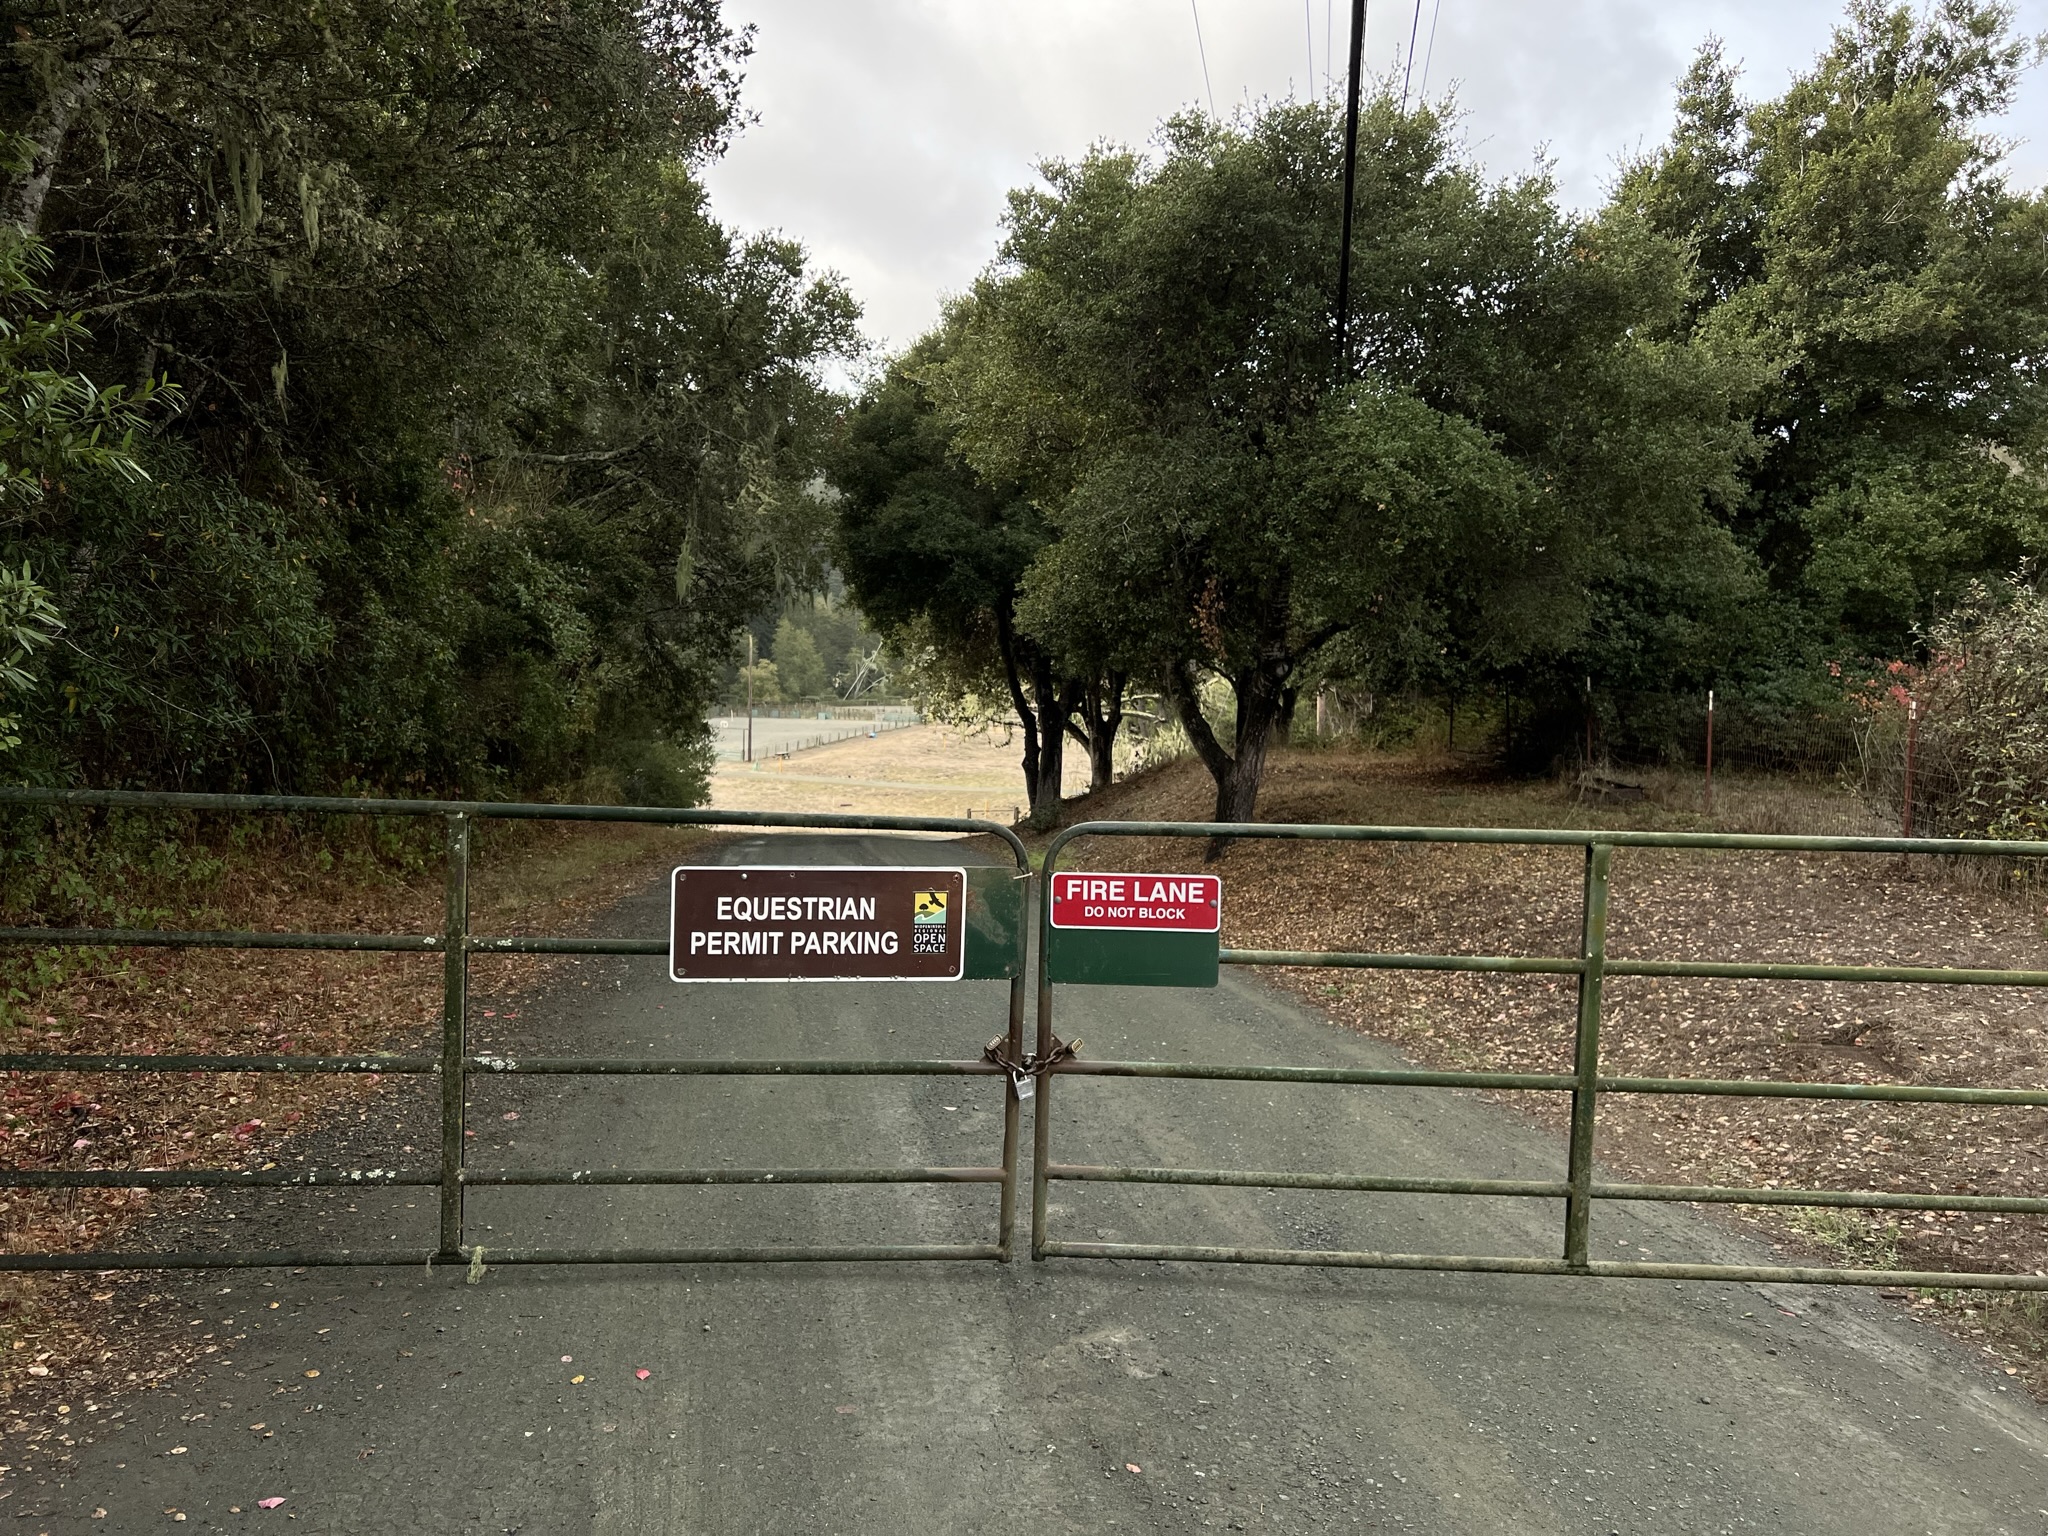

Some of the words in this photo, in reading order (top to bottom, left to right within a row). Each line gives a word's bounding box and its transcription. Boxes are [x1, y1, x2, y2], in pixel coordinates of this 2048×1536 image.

[1067, 880, 1125, 901] FIRE
[1134, 881, 1204, 903] LANE
[717, 896, 876, 921] EQUESTRIAN
[1084, 906, 1104, 917] DO
[1107, 907, 1135, 918] NOT
[1138, 908, 1186, 919] BLOCK
[690, 931, 784, 955] PERMIT
[790, 931, 899, 955] PARKING
[914, 933, 946, 943] OPEN
[913, 943, 945, 953] SPACE
